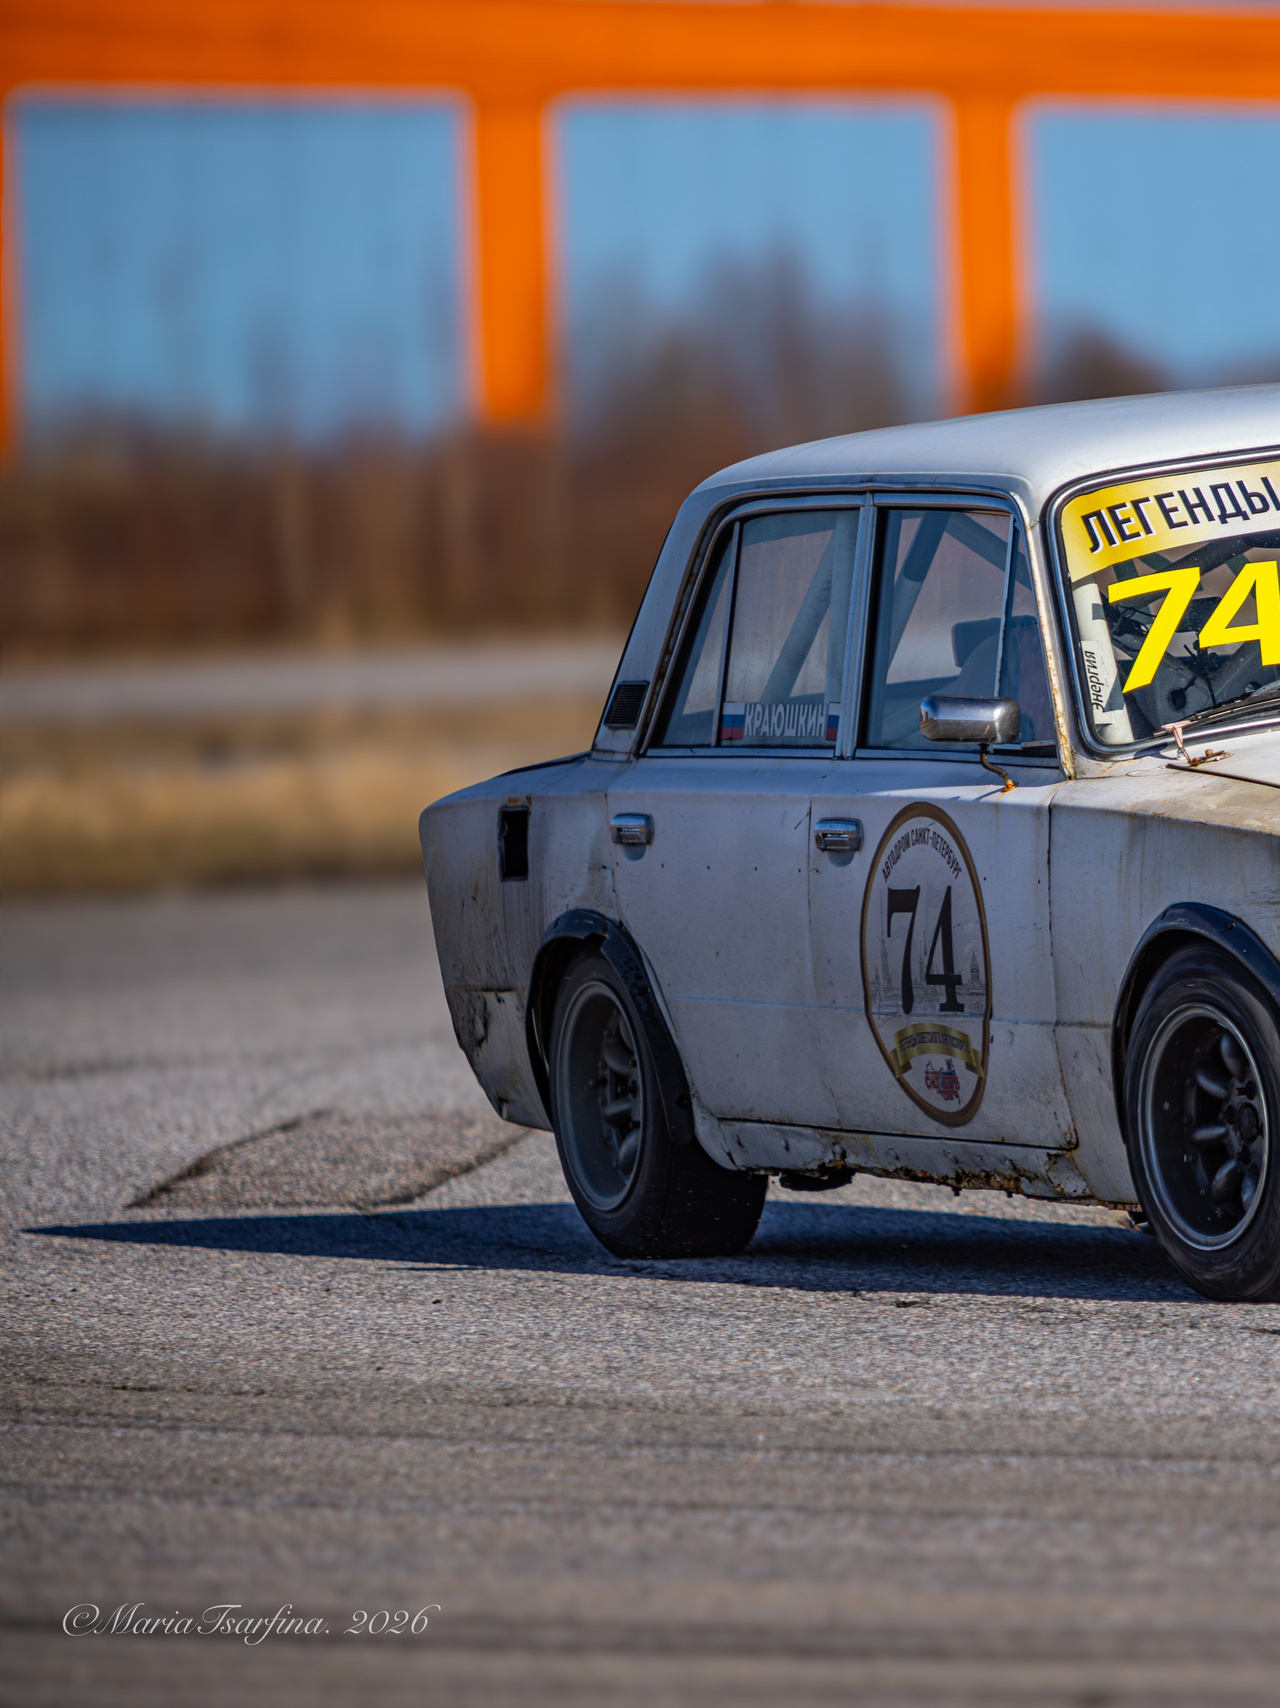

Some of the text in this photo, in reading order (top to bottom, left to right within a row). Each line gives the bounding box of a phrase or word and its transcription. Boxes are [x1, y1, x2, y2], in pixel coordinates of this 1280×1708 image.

[743, 703, 827, 738] КРАЮШКИН
[882, 827, 962, 883] АВТОДРОМ САНКТ-ПЕТЕРБУРГ
[886, 884, 965, 1015] 74
